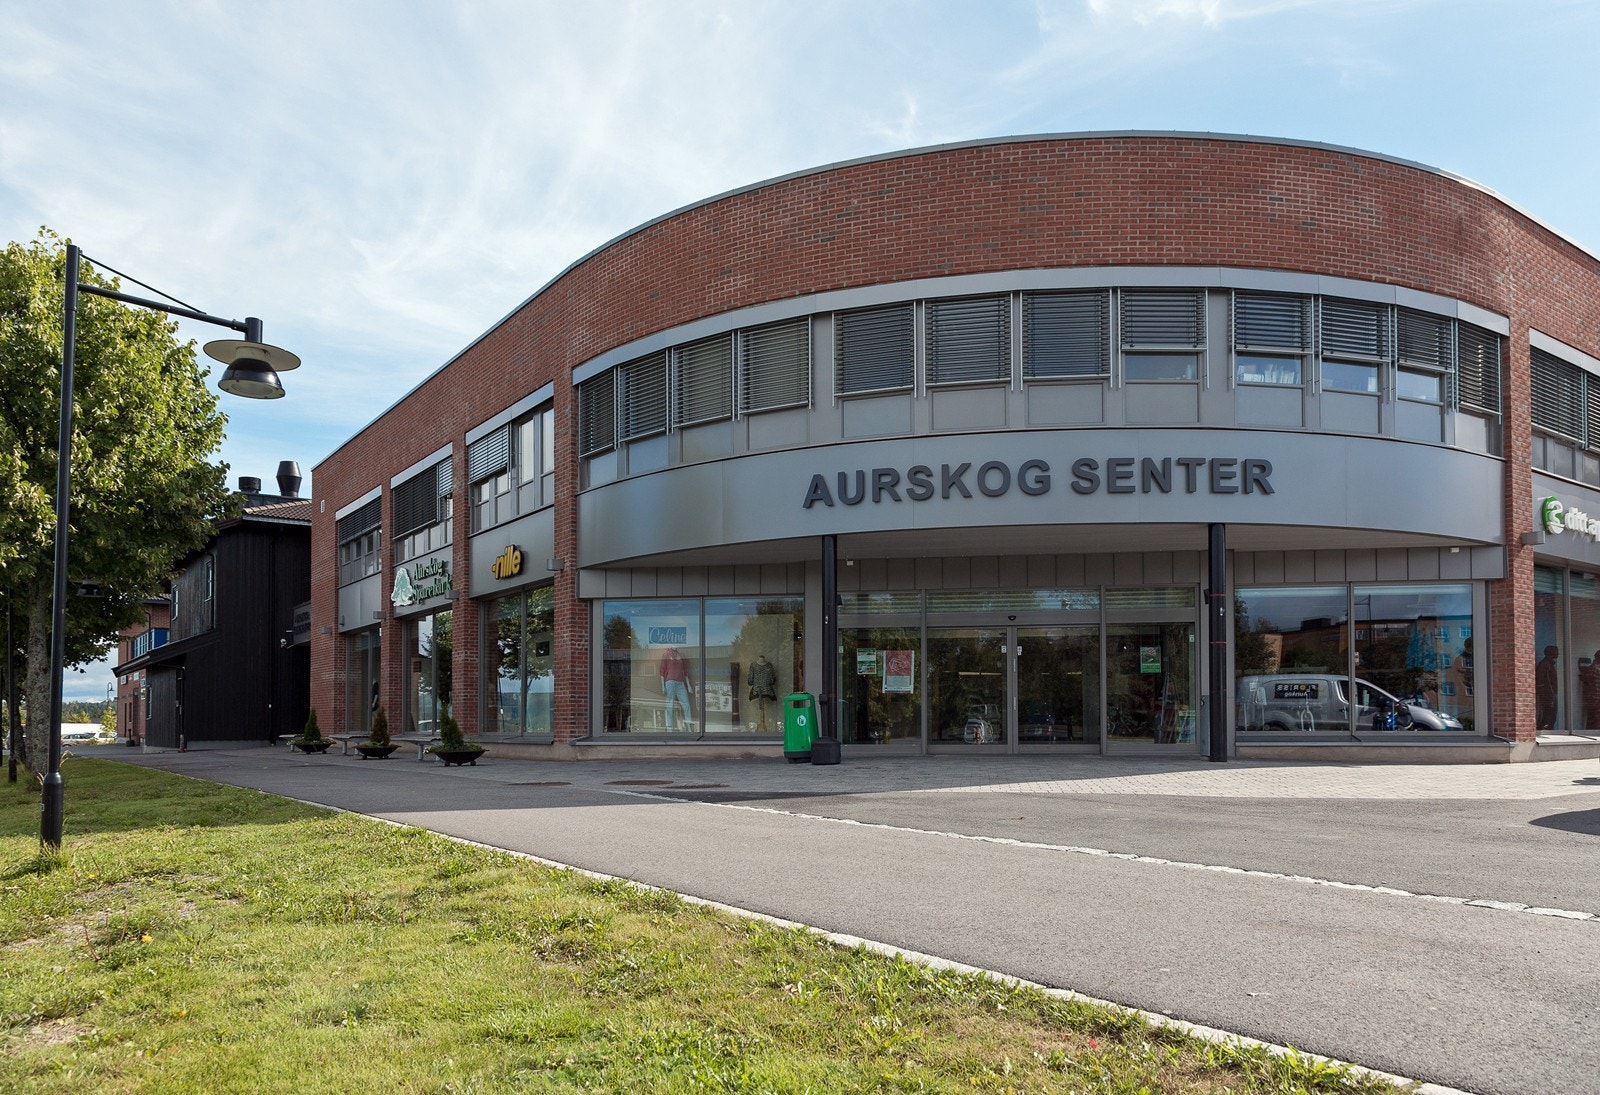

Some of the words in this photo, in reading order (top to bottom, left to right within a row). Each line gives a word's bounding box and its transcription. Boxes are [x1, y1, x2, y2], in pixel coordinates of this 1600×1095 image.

[802, 458, 1052, 508] AURSKOG
[1071, 457, 1276, 495] SENTER
[414, 557, 446, 581] Aurskog
[491, 544, 523, 580] nille
[412, 573, 453, 605] Sparebank
[650, 627, 686, 644] Celine
